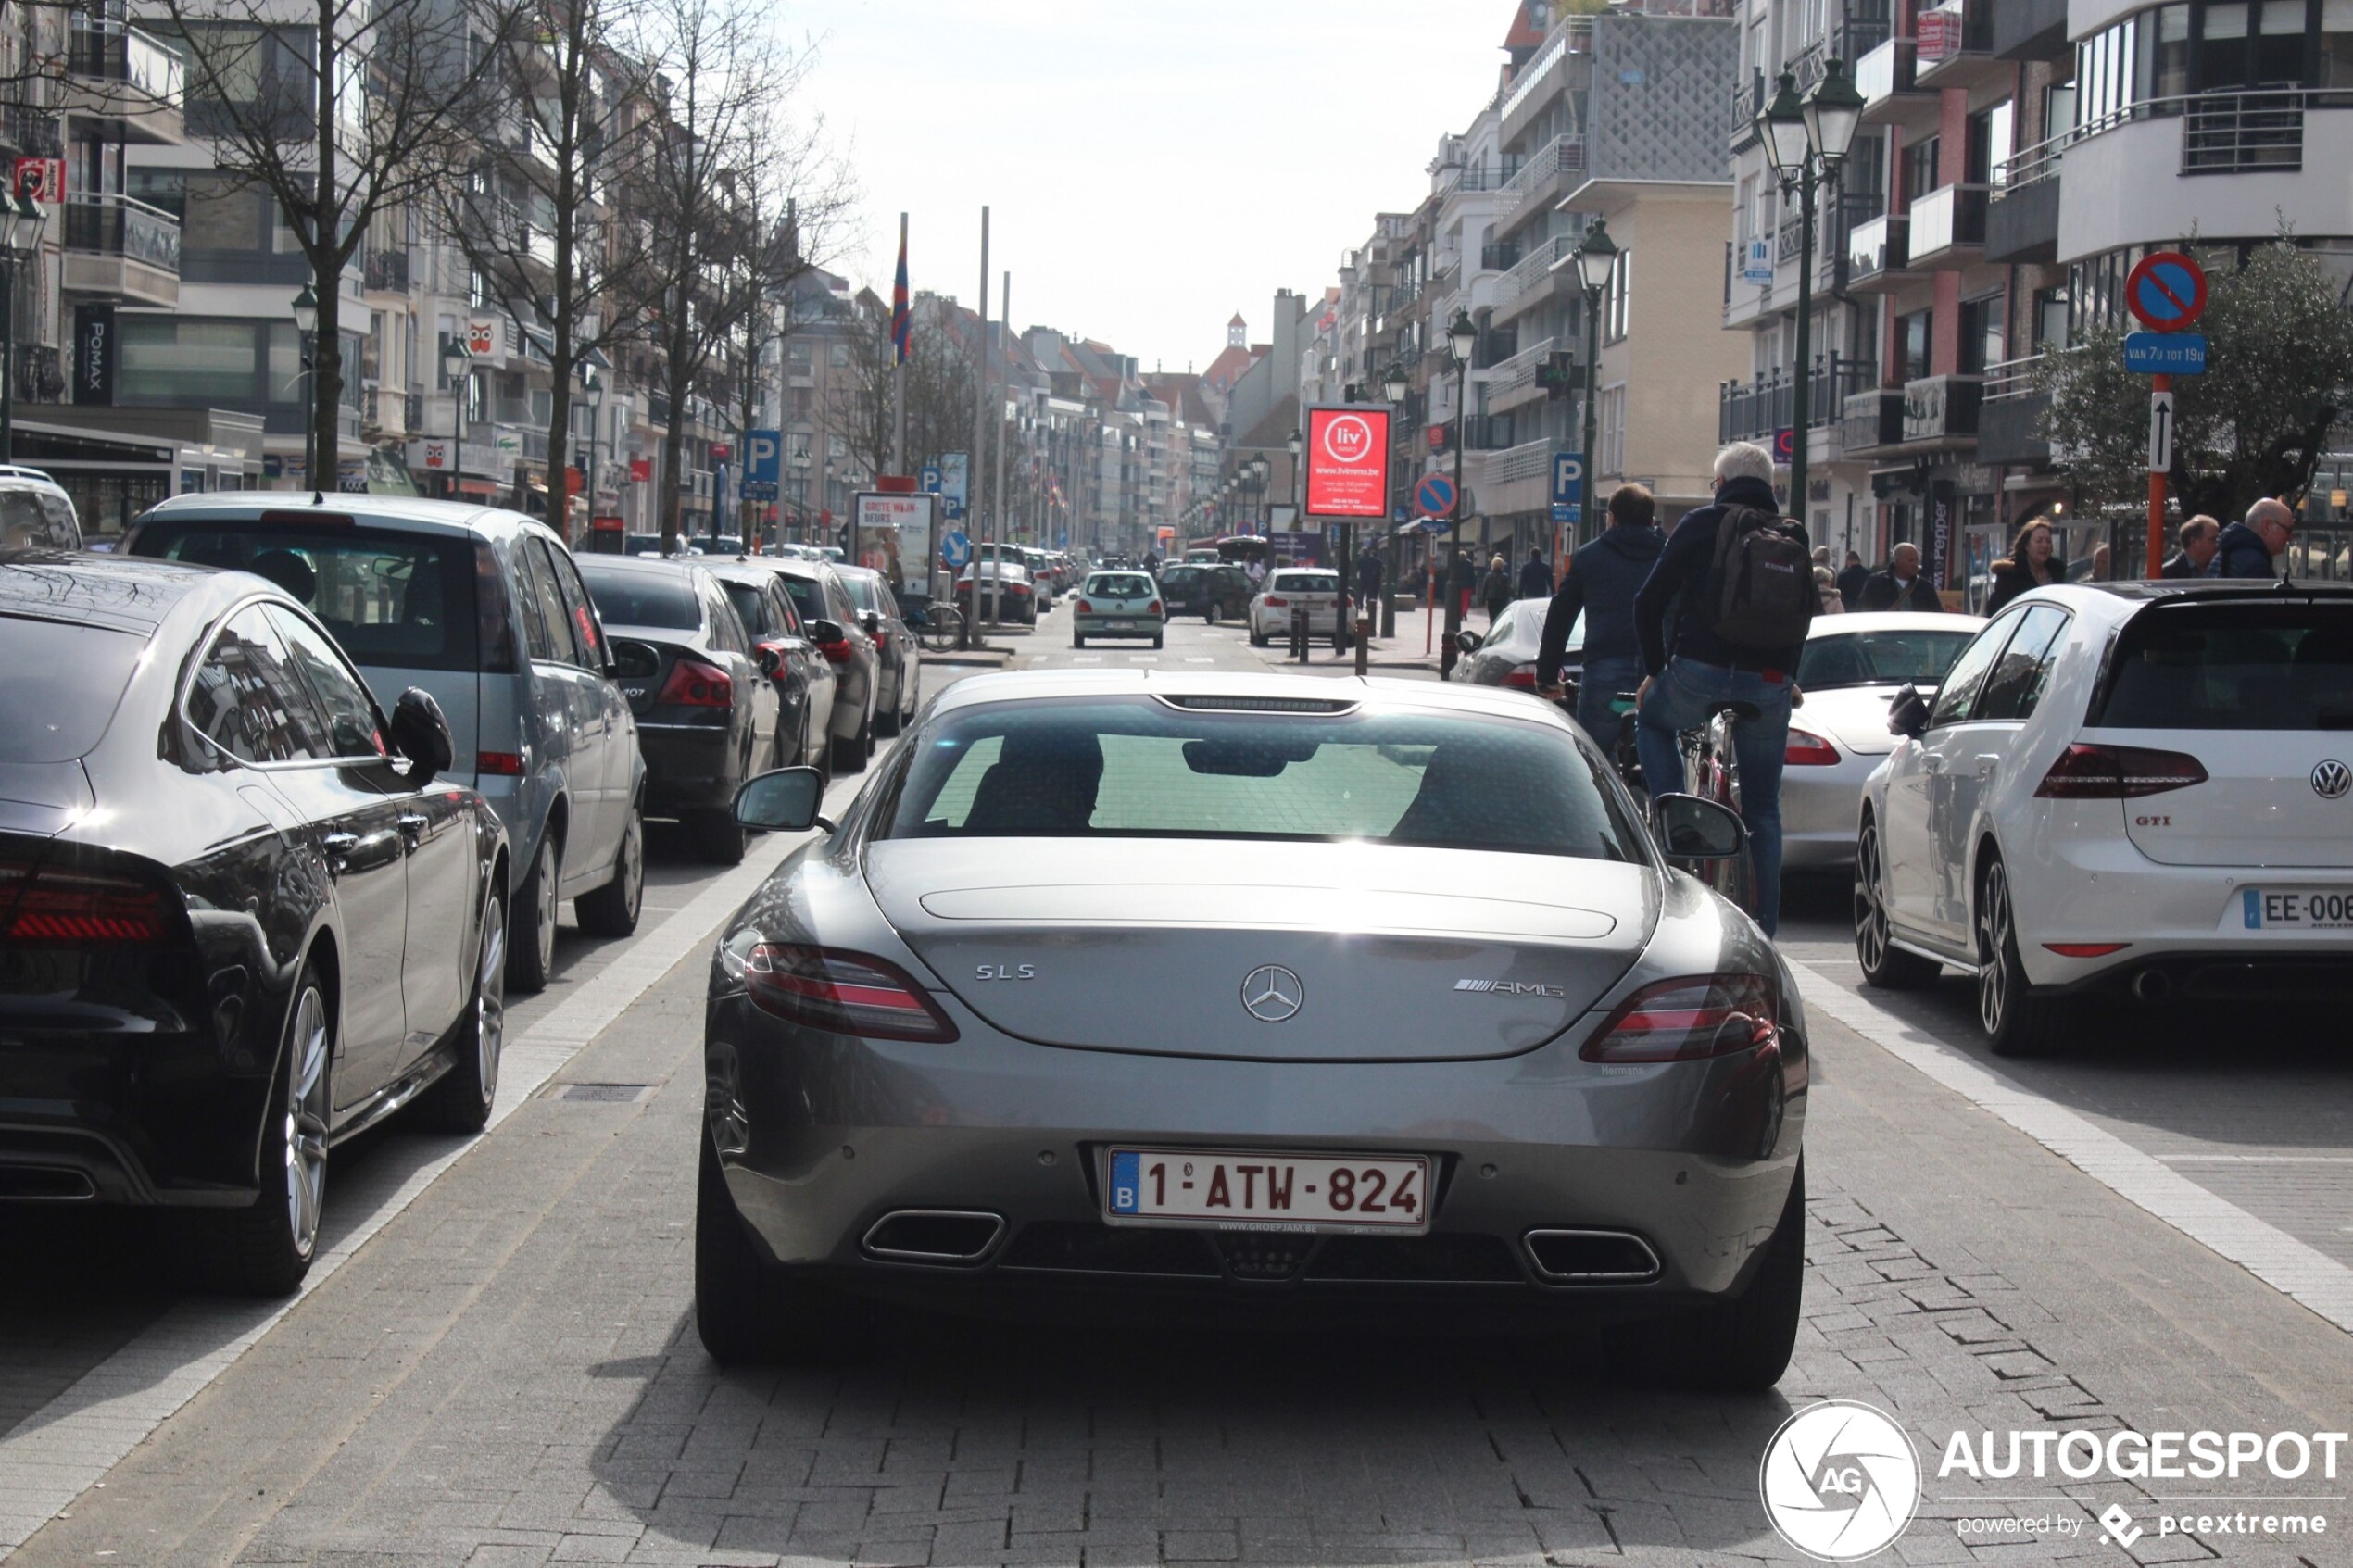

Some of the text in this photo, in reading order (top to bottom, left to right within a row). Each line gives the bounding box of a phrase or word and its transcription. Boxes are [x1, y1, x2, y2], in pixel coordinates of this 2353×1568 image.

[46, 161, 57, 198] Jupiler
[2129, 348, 2146, 359] VAN
[2168, 350, 2182, 360] TOT
[749, 438, 774, 474] P
[1315, 467, 1379, 476] www.livimmo.be
[1558, 459, 1582, 494] P
[924, 471, 938, 492] P
[864, 501, 891, 512] GROTE
[946, 499, 958, 516] P
[864, 513, 891, 523] BEURS
[1934, 500, 1948, 560] Pepper
[2135, 816, 2171, 826] GTI
[975, 963, 1036, 980] SLS
[1489, 979, 1565, 997] AMG
[1116, 1187, 1133, 1207] B
[1218, 1222, 1317, 1234] WWW.GROEPJAM.BE
